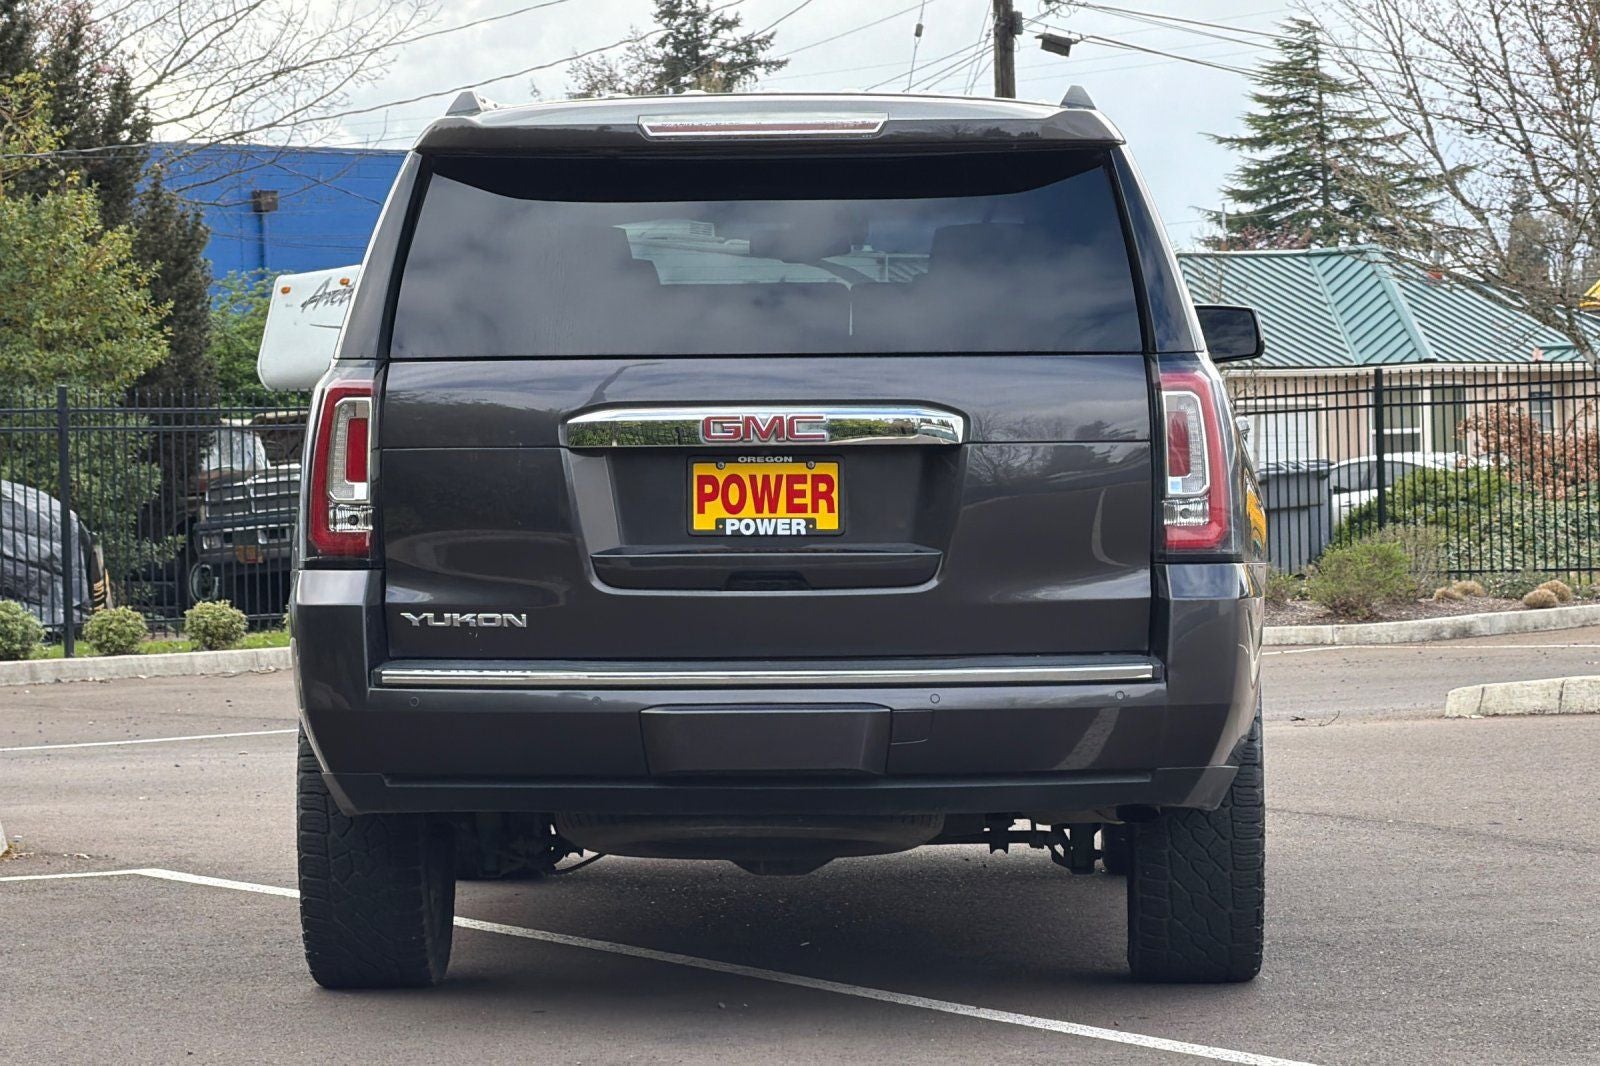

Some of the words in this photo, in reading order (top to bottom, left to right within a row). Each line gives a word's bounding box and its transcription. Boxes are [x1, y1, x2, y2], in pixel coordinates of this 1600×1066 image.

[702, 414, 828, 442] GMC
[737, 455, 793, 463] OREGON
[696, 473, 836, 515] POWER
[724, 518, 807, 536] POWER
[400, 612, 527, 628] YUKON
